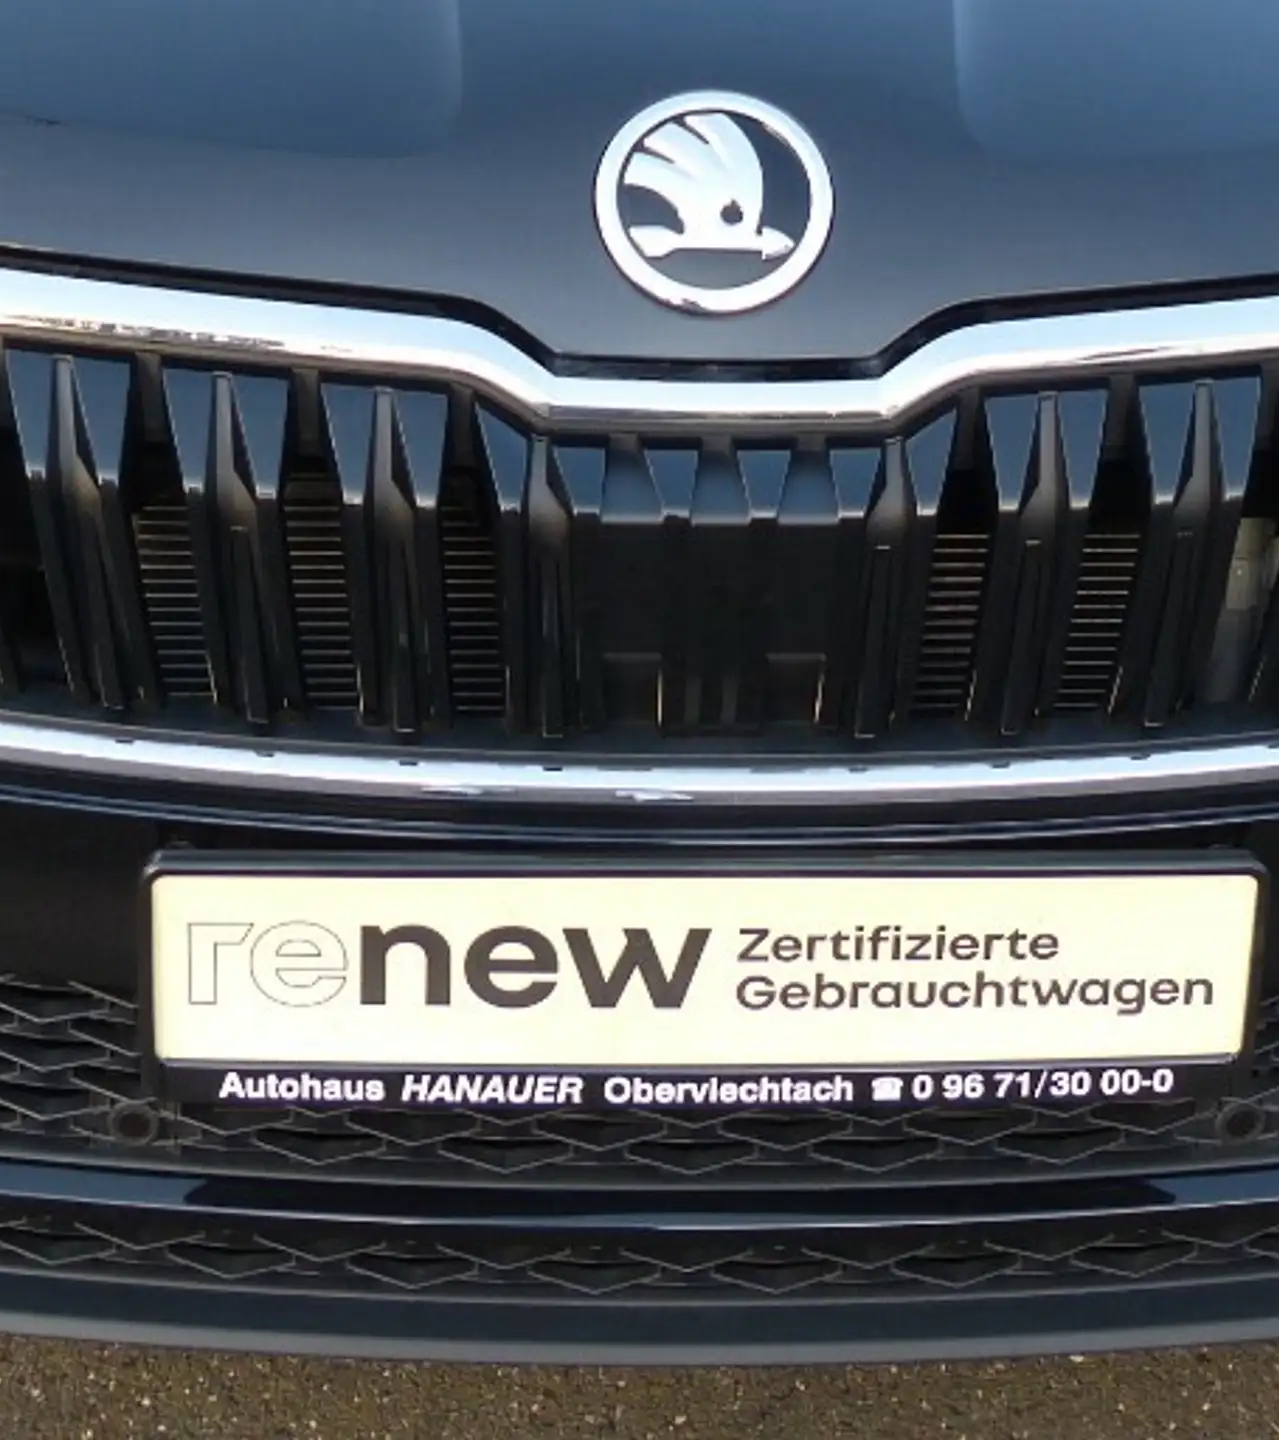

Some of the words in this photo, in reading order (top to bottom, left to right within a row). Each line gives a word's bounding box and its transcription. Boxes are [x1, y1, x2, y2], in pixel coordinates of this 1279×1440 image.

[738, 925, 1058, 962] Zertifizierte
[187, 921, 712, 1009] renew
[737, 971, 1213, 1015] Gebrauchtwagen
[219, 1072, 385, 1101] Autohaus
[402, 1075, 583, 1103] HANAUER
[913, 1075, 933, 1099] 0
[942, 1073, 984, 1098] 96
[994, 1071, 1091, 1097] 71/30
[1100, 1070, 1173, 1094] 00-0
